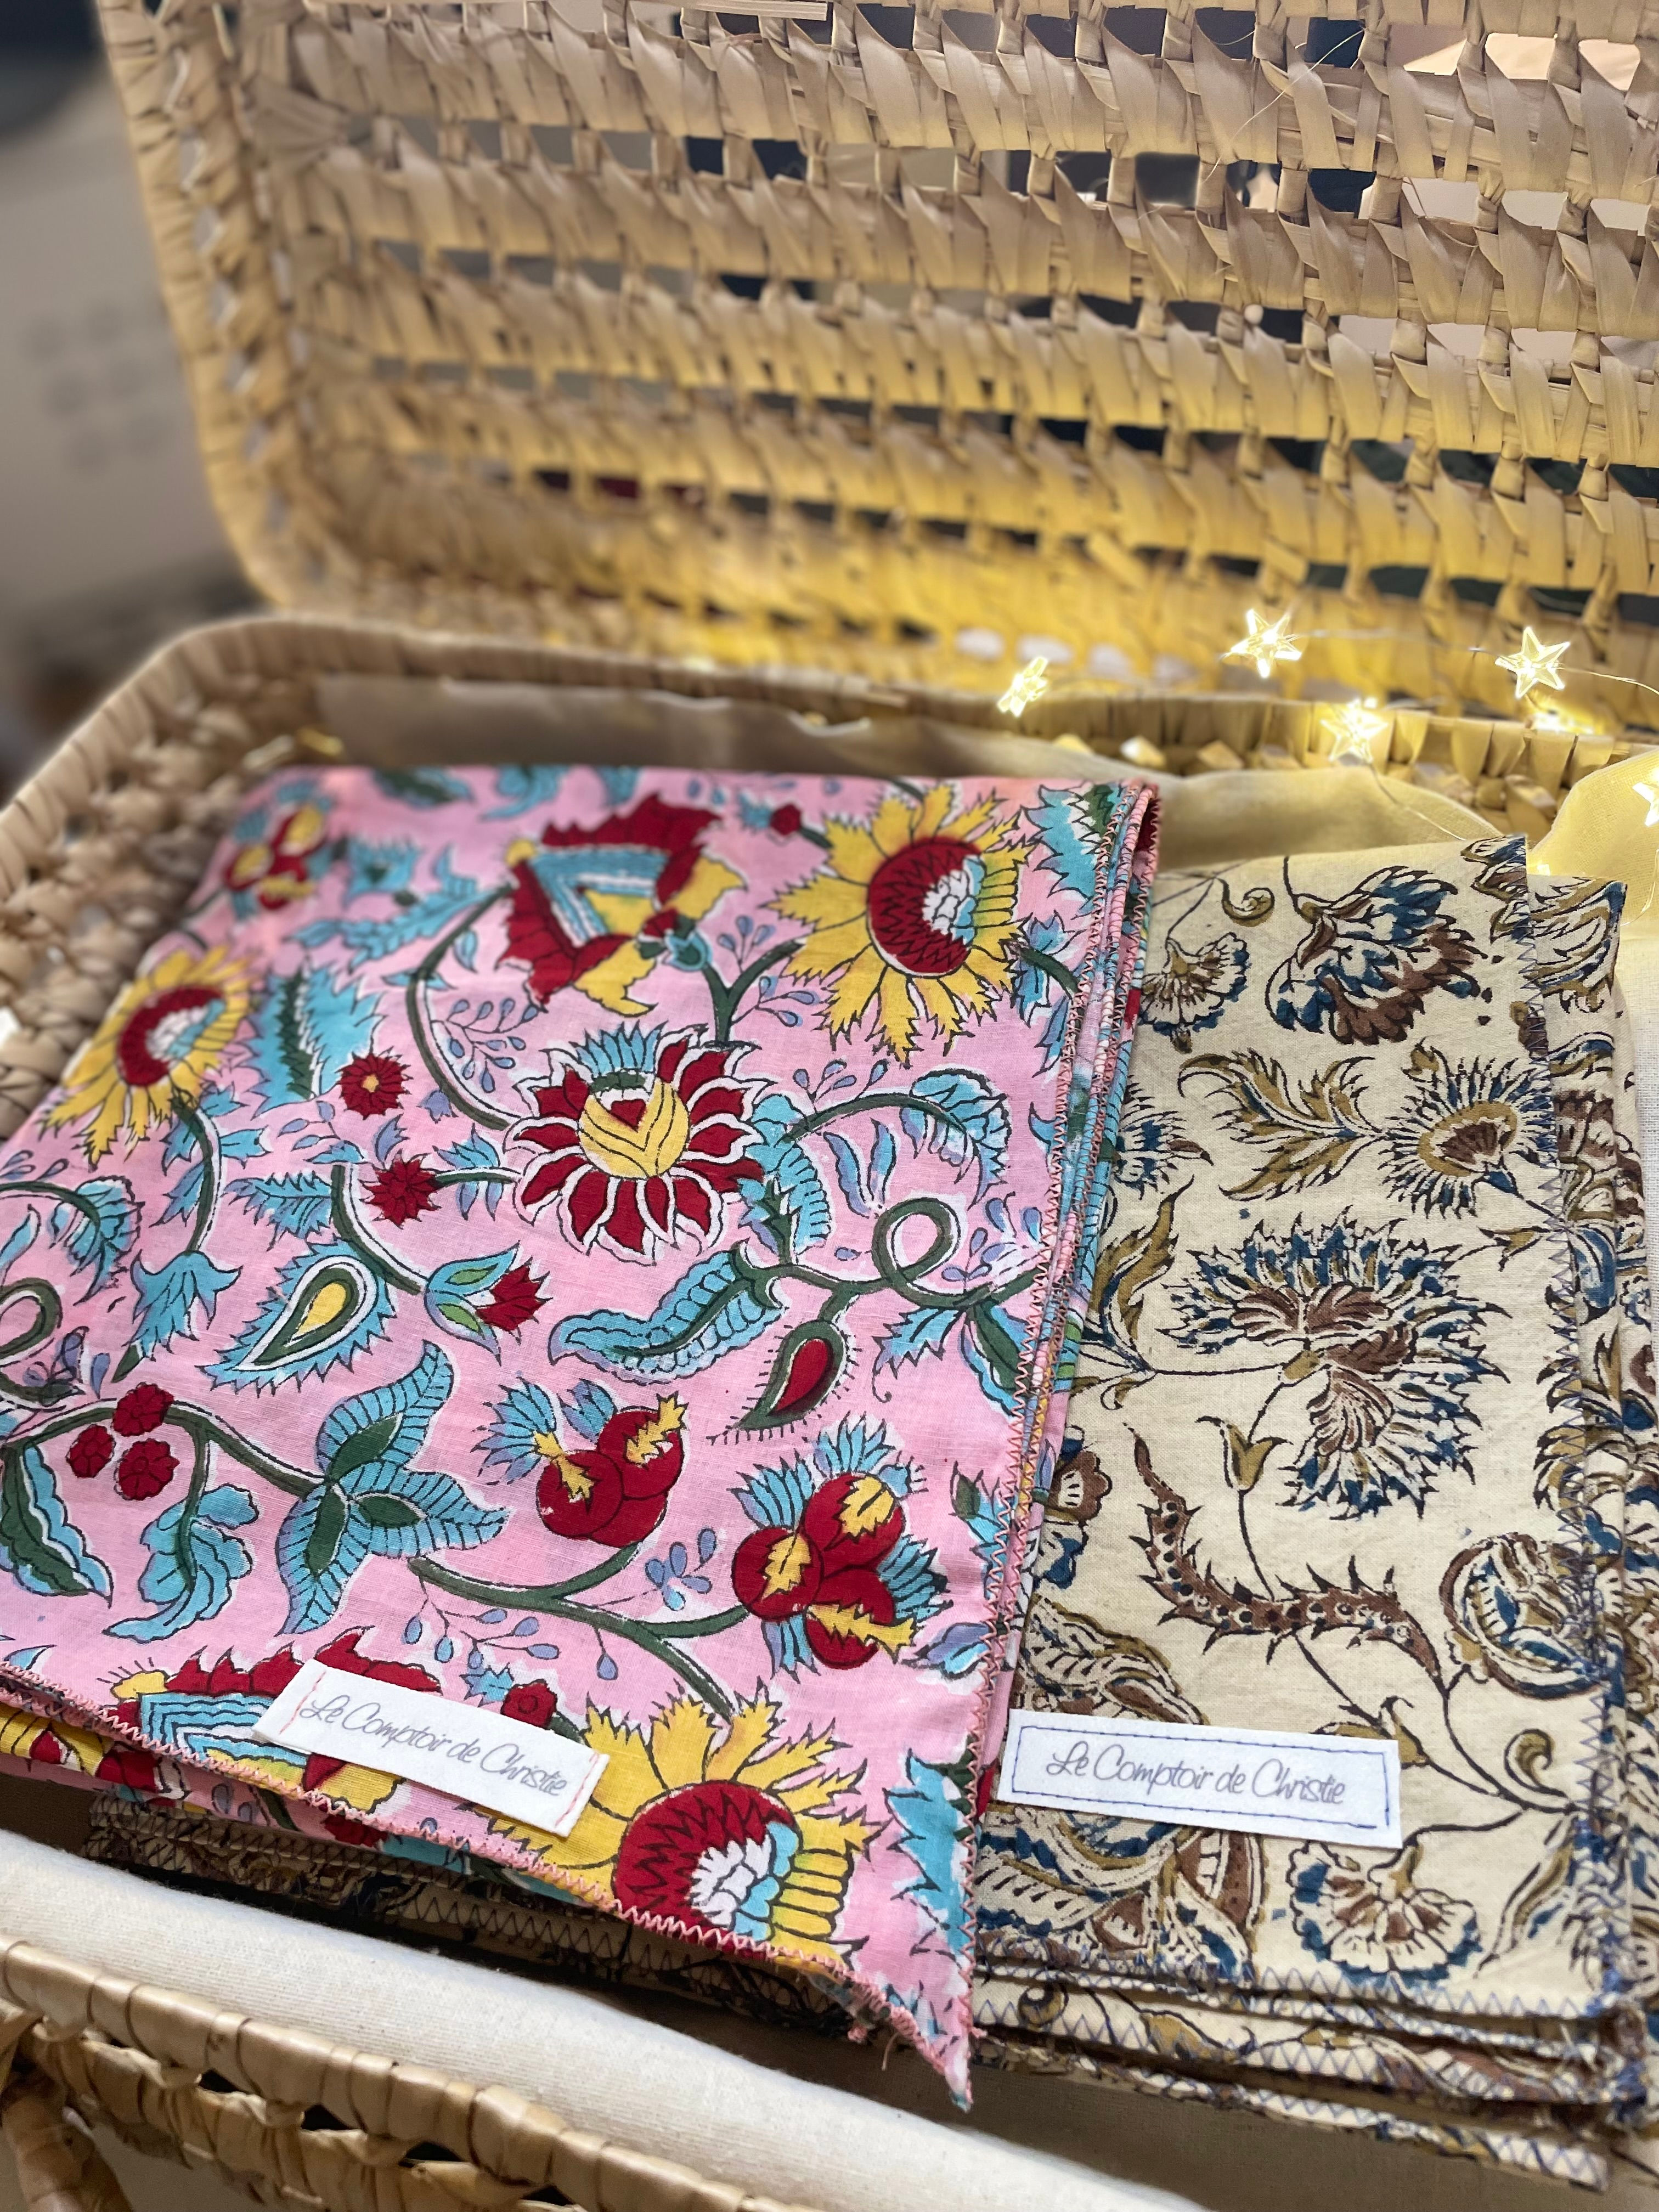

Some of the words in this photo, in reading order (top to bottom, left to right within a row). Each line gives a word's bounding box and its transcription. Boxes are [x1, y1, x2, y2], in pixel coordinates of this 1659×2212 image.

[300, 1694, 350, 1723] Le
[342, 1702, 450, 1752] Comptoir
[447, 1737, 482, 1763] de
[480, 1742, 568, 1797] Christie
[1046, 1741, 1090, 1776] Le
[1092, 1743, 1214, 1795] Comptoir
[1215, 1763, 1246, 1795] de
[1252, 1758, 1346, 1805] Christie
